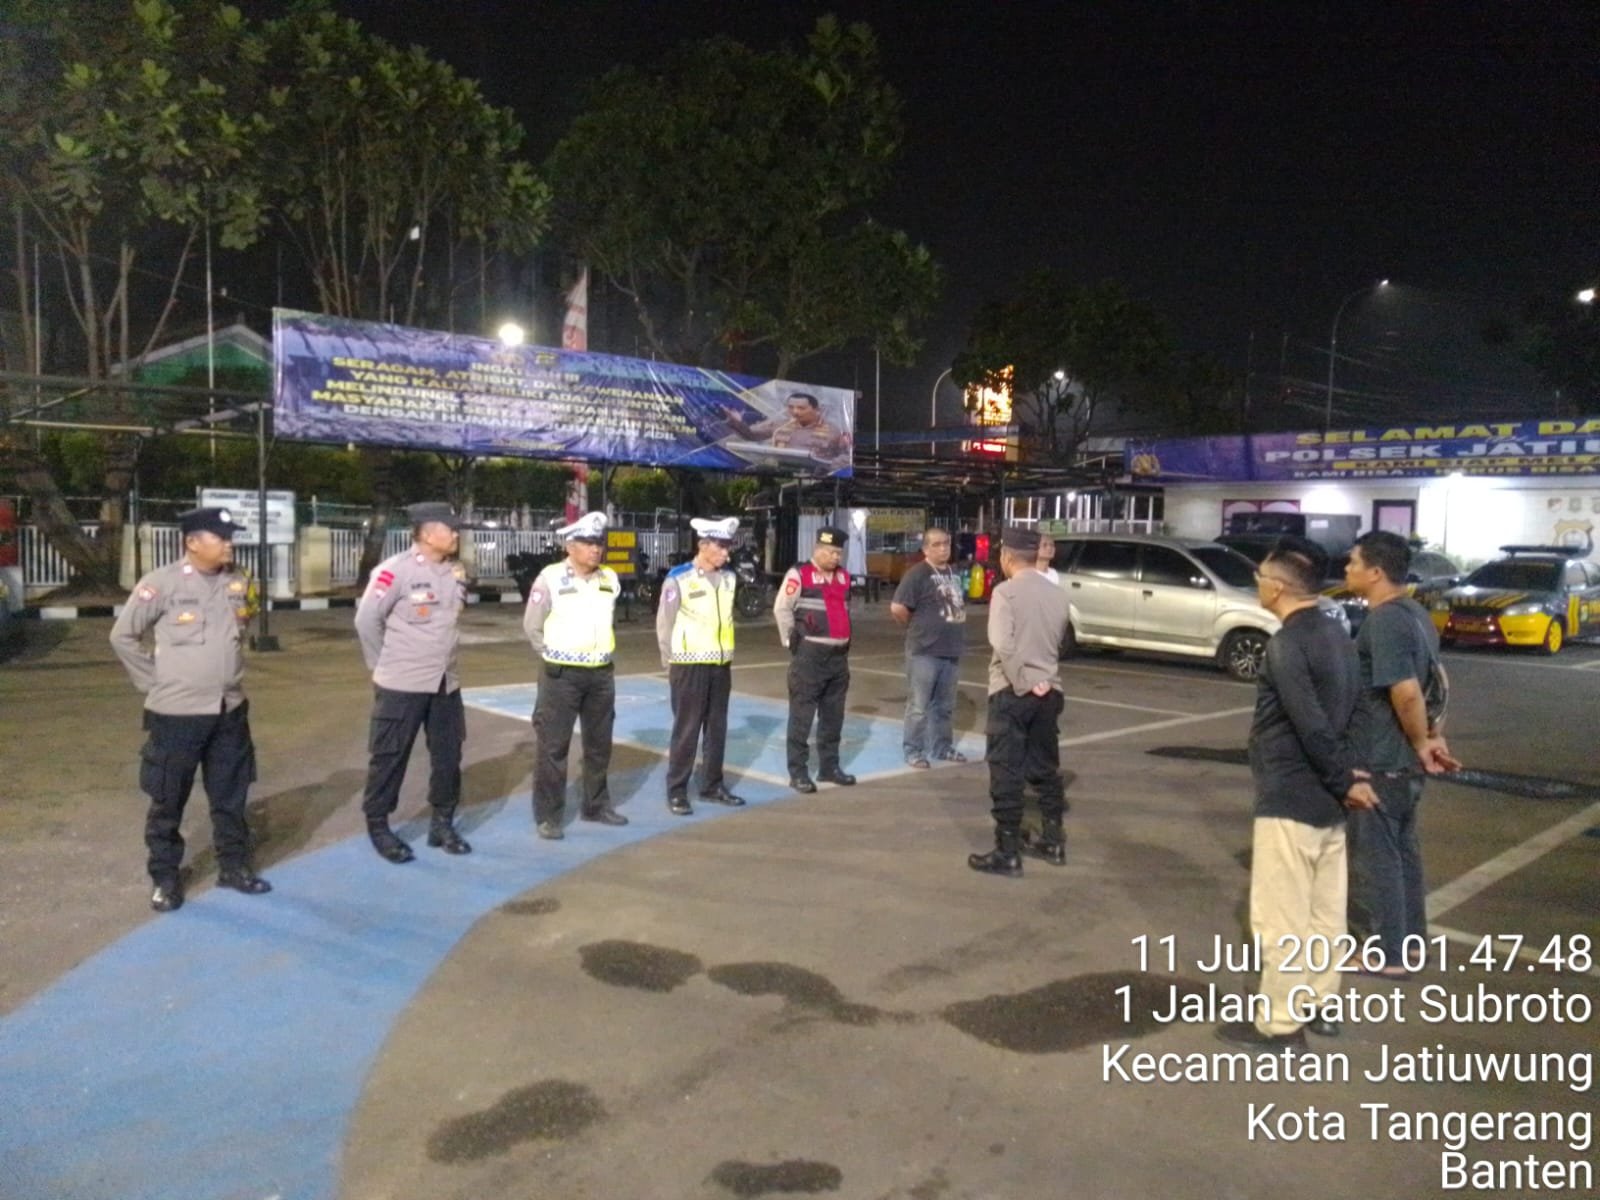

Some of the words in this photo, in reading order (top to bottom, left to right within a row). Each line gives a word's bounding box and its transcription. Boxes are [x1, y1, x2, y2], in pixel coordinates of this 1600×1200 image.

[332, 356, 440, 379] SERAGAM,
[445, 370, 529, 389] ATRIBUT,
[311, 389, 459, 413] MASYARAKAT
[326, 379, 460, 403] MELINDUNGI,
[574, 404, 608, 417] DAN
[350, 370, 409, 386] YANG
[411, 378, 487, 393] KALIAN
[621, 399, 672, 413] UNTUK
[343, 404, 435, 421] DENGAN
[643, 431, 677, 441] ADIL
[1296, 423, 1522, 445] SELAMAT
[1538, 419, 1600, 435] DA
[1265, 446, 1442, 462] POLSEK
[1354, 460, 1425, 469] KAMI
[1437, 457, 1504, 467] SIAP
[1294, 470, 1346, 479] KAMI
[1530, 465, 1598, 474] BISA
